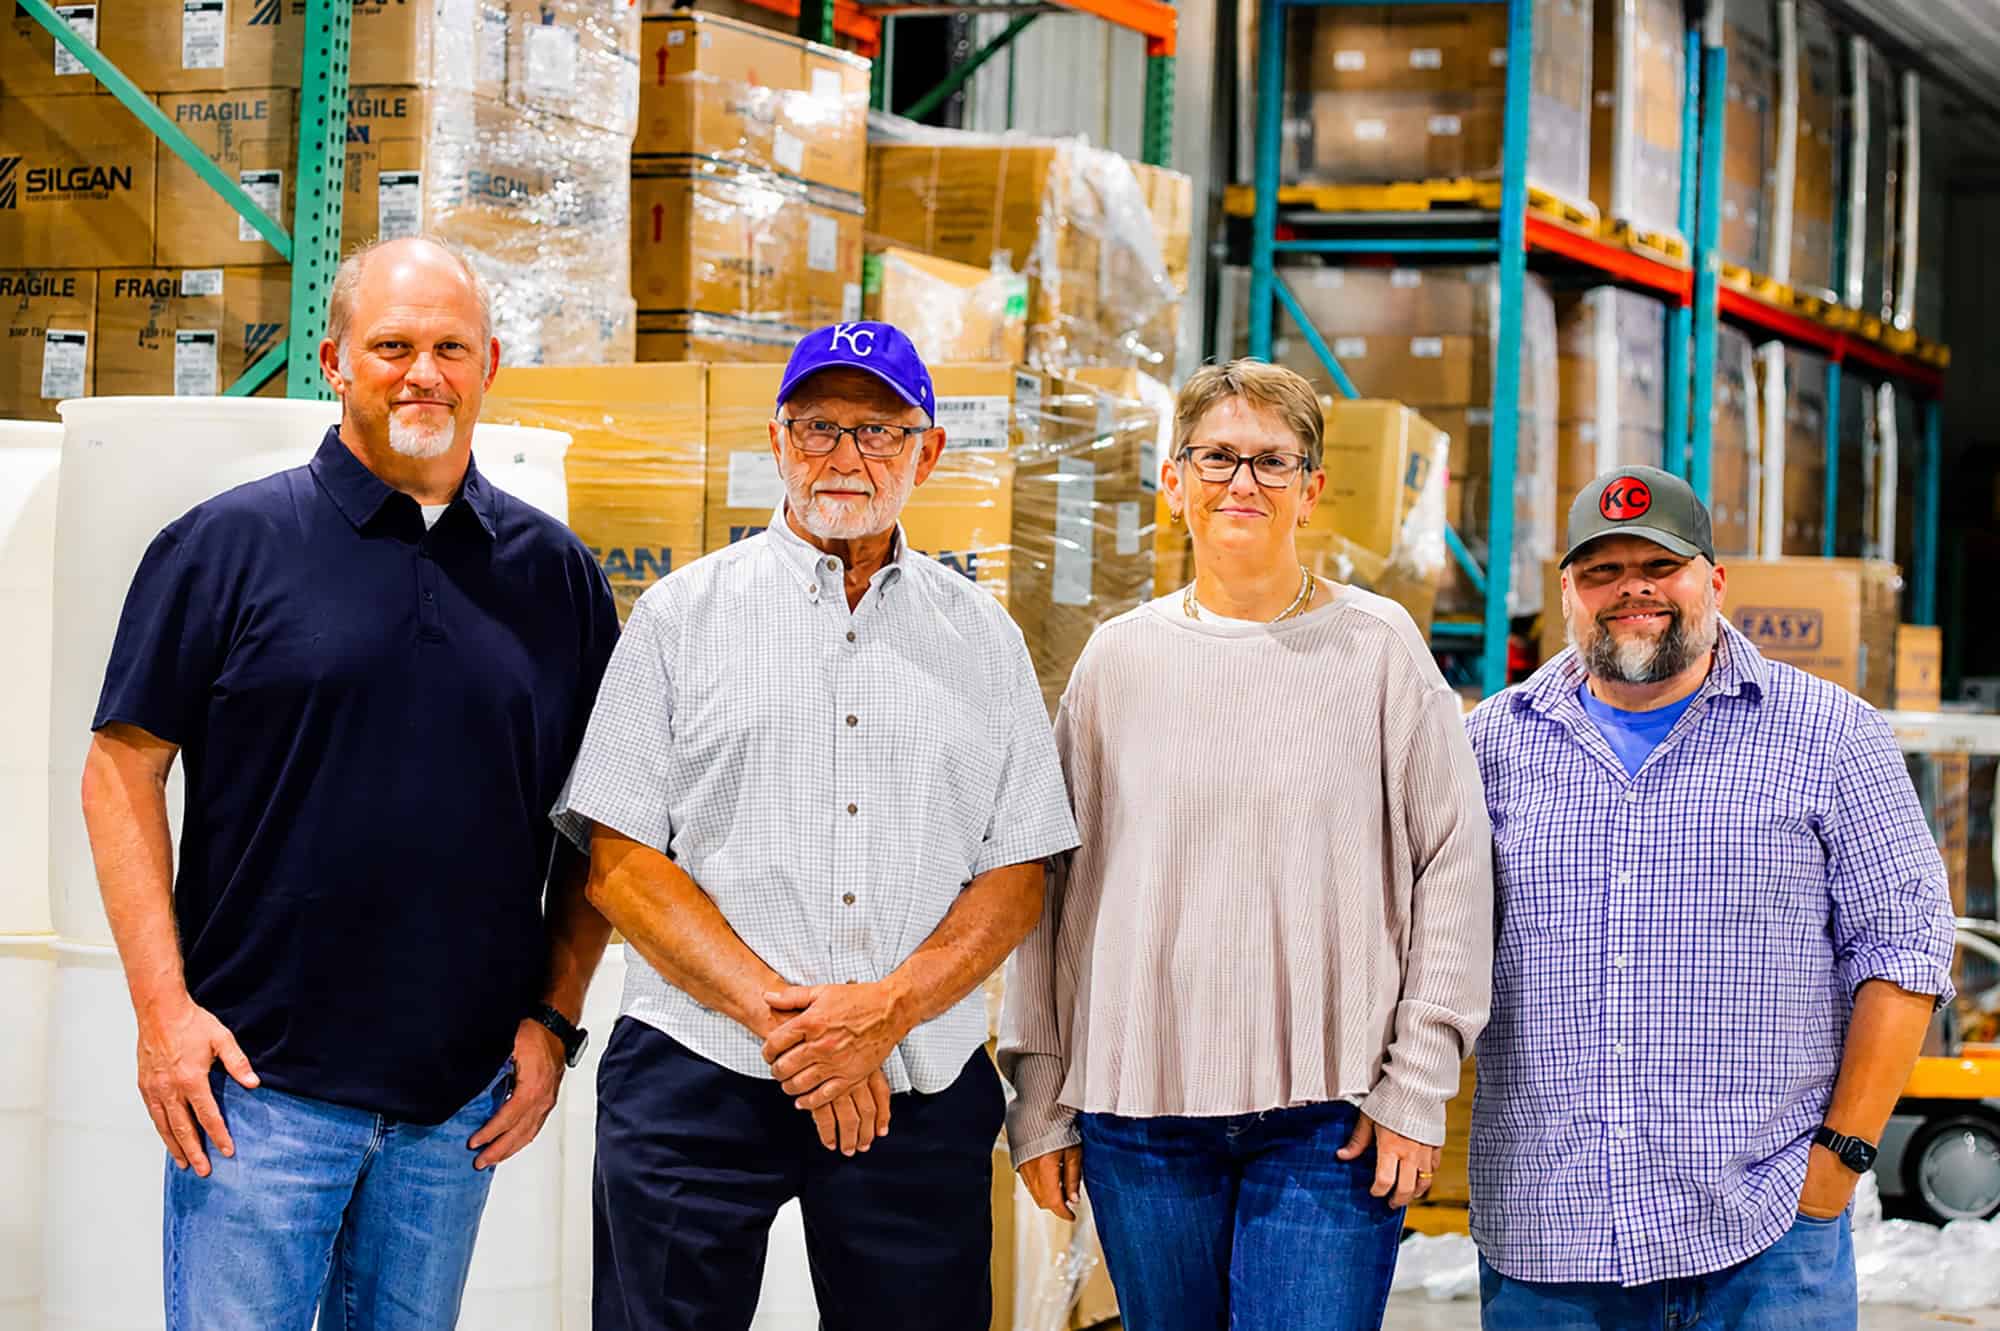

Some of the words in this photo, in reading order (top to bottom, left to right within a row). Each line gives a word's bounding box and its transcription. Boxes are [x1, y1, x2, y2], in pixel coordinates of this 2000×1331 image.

[176, 100, 268, 121] FRAGILE
[26, 165, 132, 193] SILGAN
[114, 278, 205, 298] FRAGIL
[829, 323, 875, 357] KC
[1604, 487, 1647, 511] KC
[1743, 616, 1812, 639] EASY
